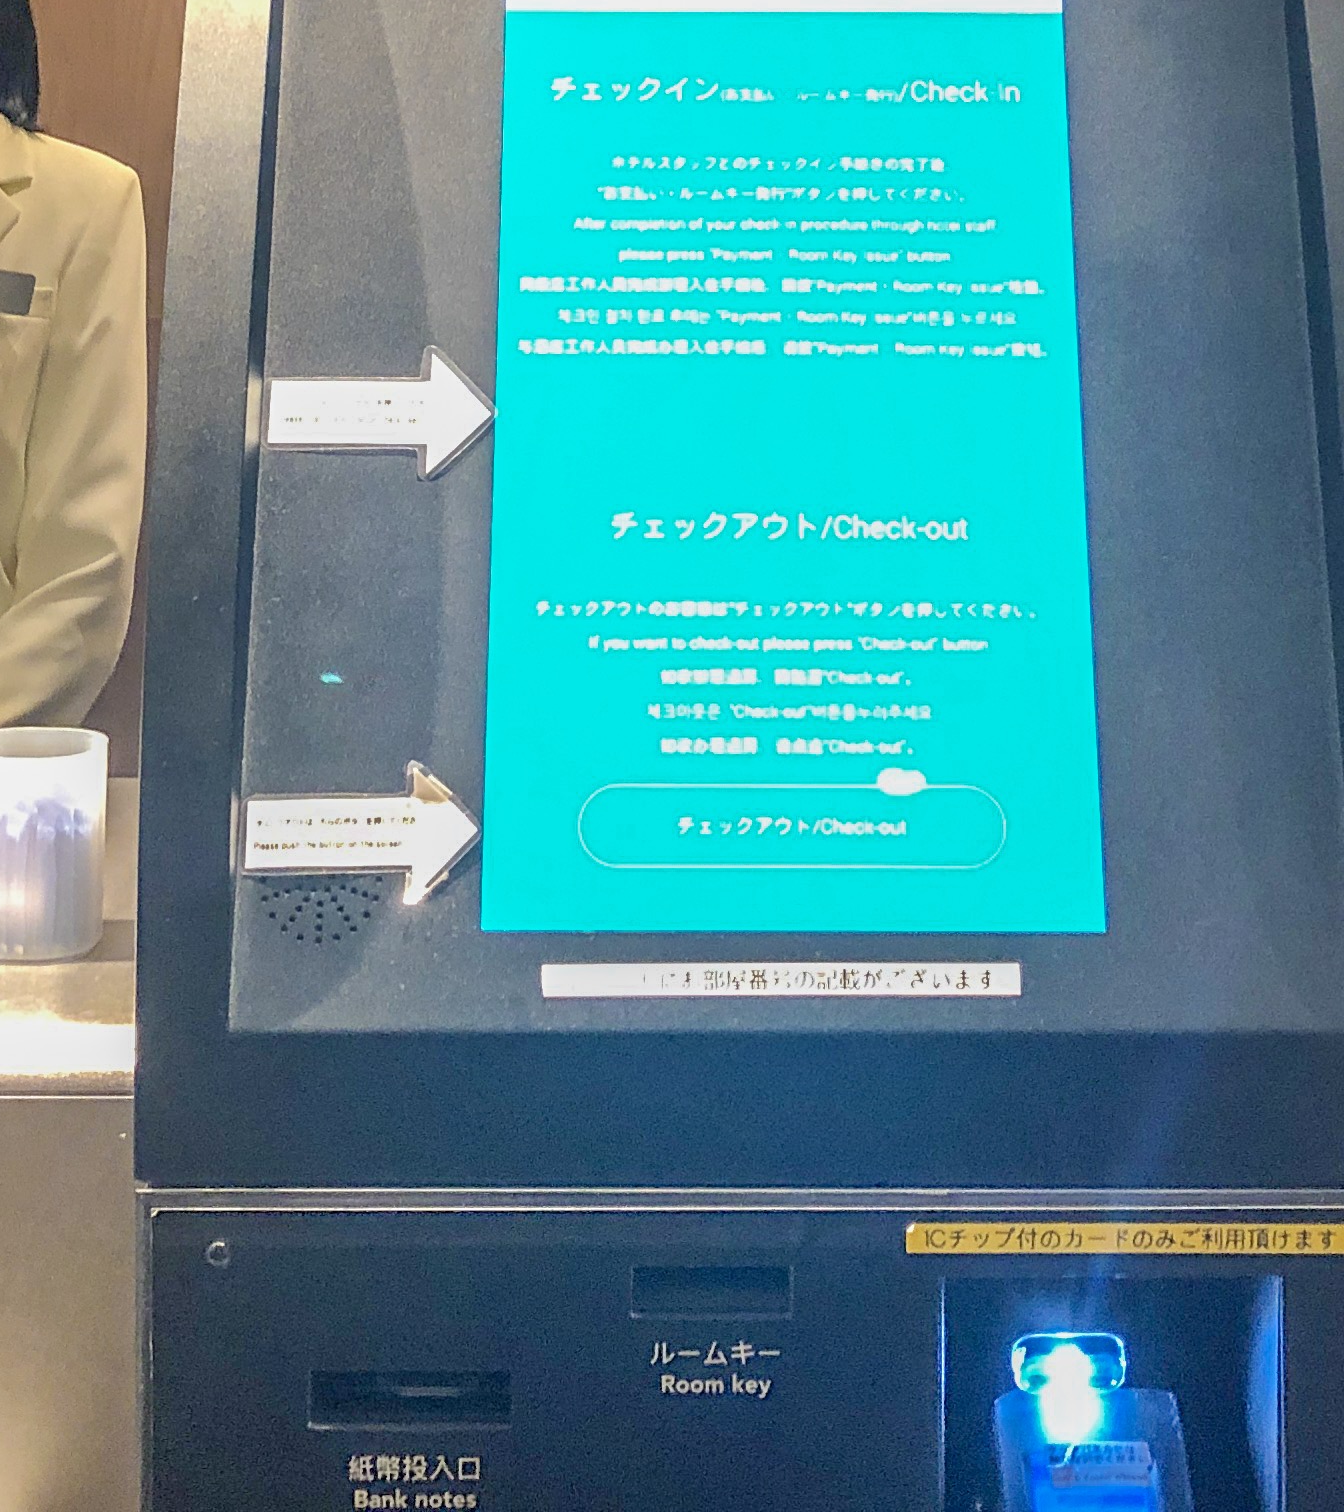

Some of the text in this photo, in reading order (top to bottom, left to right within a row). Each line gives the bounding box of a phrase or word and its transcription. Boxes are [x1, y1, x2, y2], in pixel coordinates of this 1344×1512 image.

[611, 512, 968, 540] チェックアウト/Check-out
[672, 638, 686, 650] to
[925, 1228, 1338, 1251] ICチップ付のカードのみご利用頂けます
[651, 1340, 782, 1366] ルームキー
[660, 1374, 773, 1399] Room key
[348, 1455, 482, 1482] 紙幣投入口
[353, 1489, 478, 1510] Bank notes
